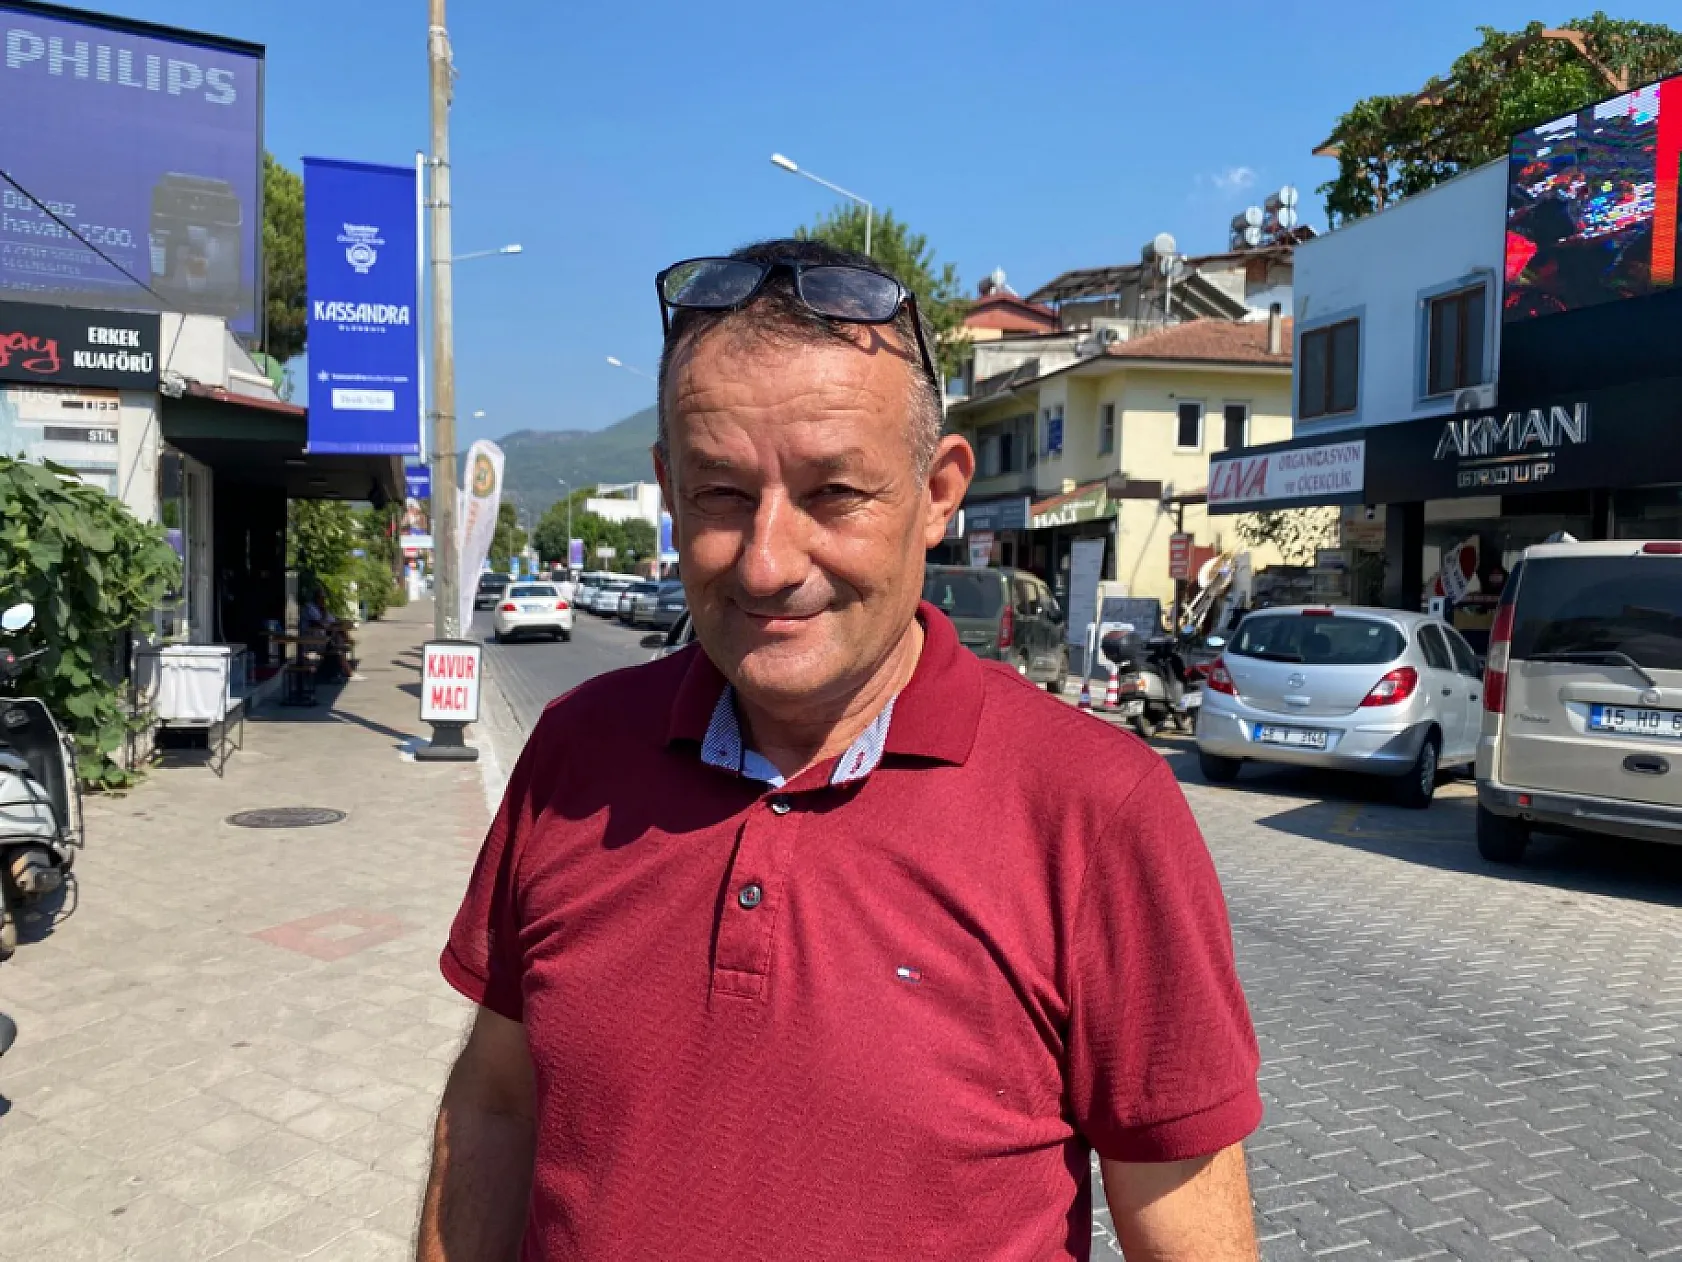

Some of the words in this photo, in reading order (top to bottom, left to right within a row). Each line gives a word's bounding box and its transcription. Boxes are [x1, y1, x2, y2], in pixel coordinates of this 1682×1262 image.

[6, 28, 237, 105] PHILIPS
[314, 301, 410, 325] KASSANDRA
[87, 326, 140, 347] ERKEK
[73, 350, 153, 373] KUAFÖRÜ
[1433, 402, 1588, 461] AKMAN
[1457, 463, 1555, 488] GROUP
[428, 654, 475, 679] KAVUR
[431, 685, 468, 711] MACI
[1605, 707, 1625, 725] 15
